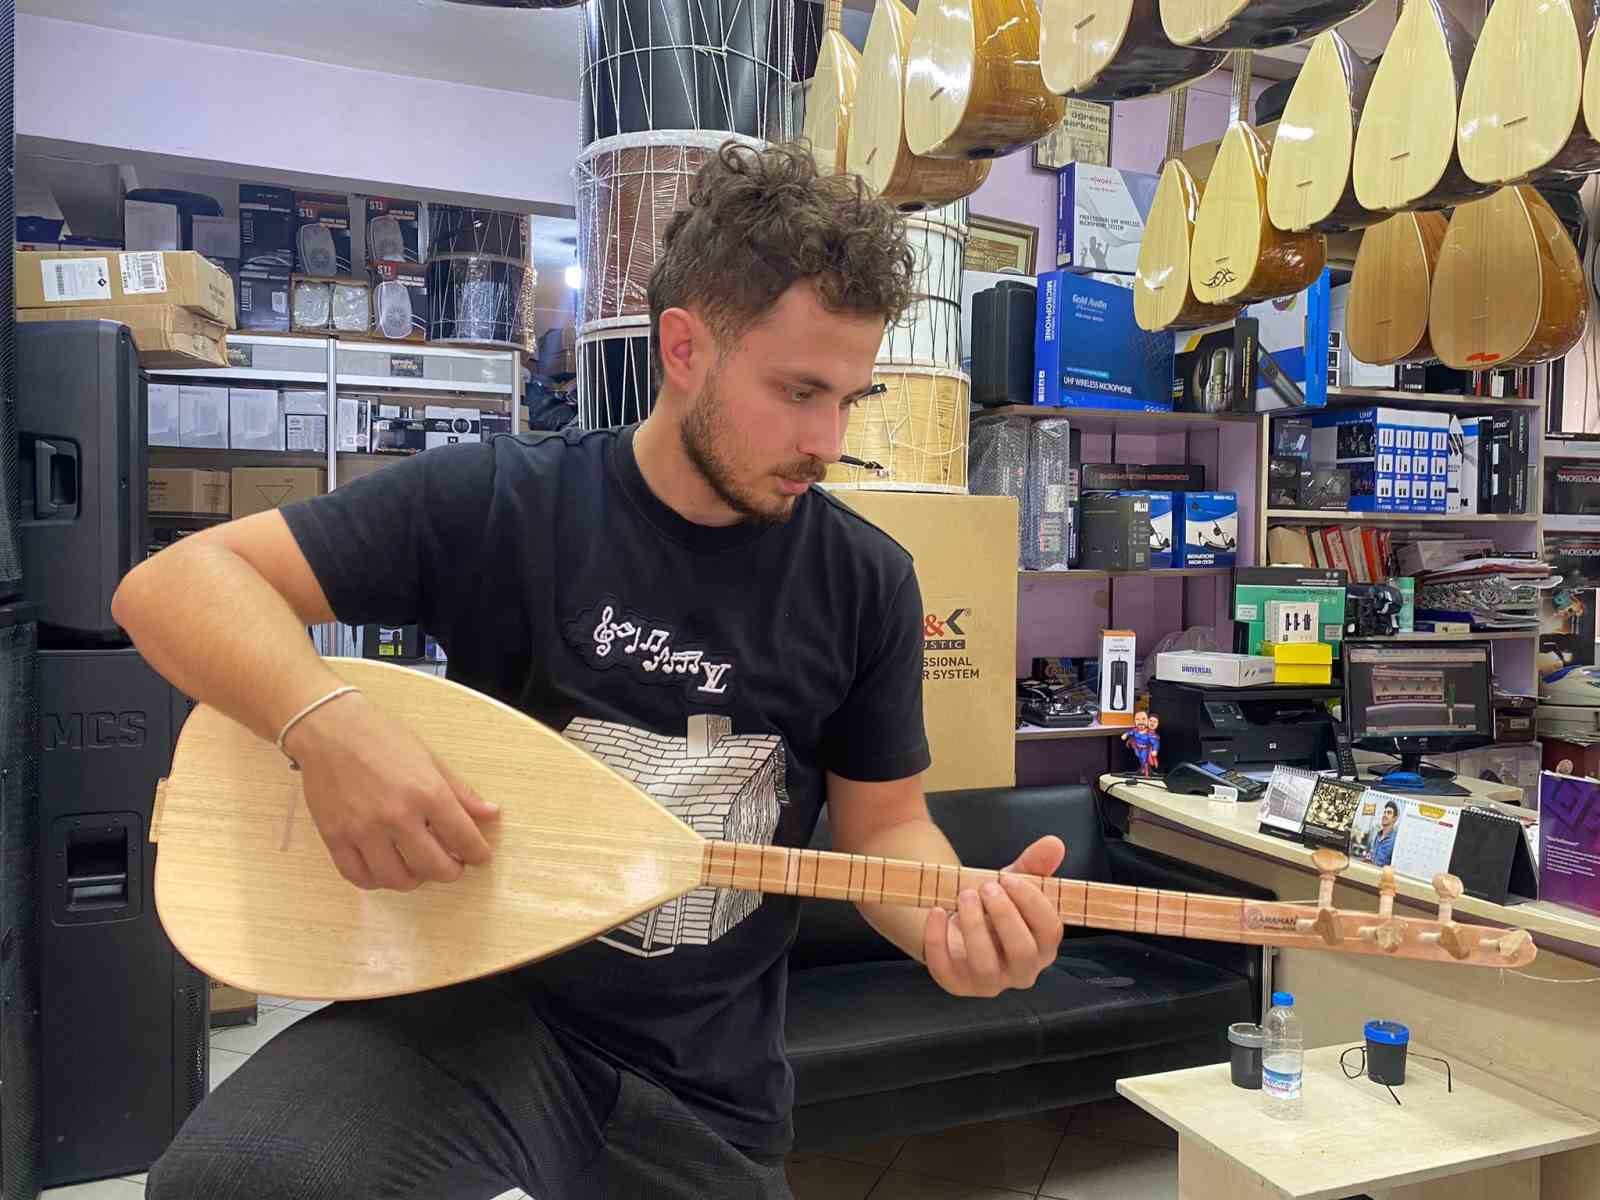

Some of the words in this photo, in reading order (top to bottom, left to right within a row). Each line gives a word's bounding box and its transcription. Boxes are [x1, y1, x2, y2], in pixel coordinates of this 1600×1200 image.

[1044, 280, 1053, 343] MICROPHONE
[1063, 376, 1074, 385] UHF
[1074, 377, 1099, 390] WIRELESS
[1099, 380, 1133, 395] MICROPHONE
[933, 669, 980, 680] SYSTEM
[1181, 664, 1213, 674] UNIVERSAL
[42, 711, 147, 750] MCS
